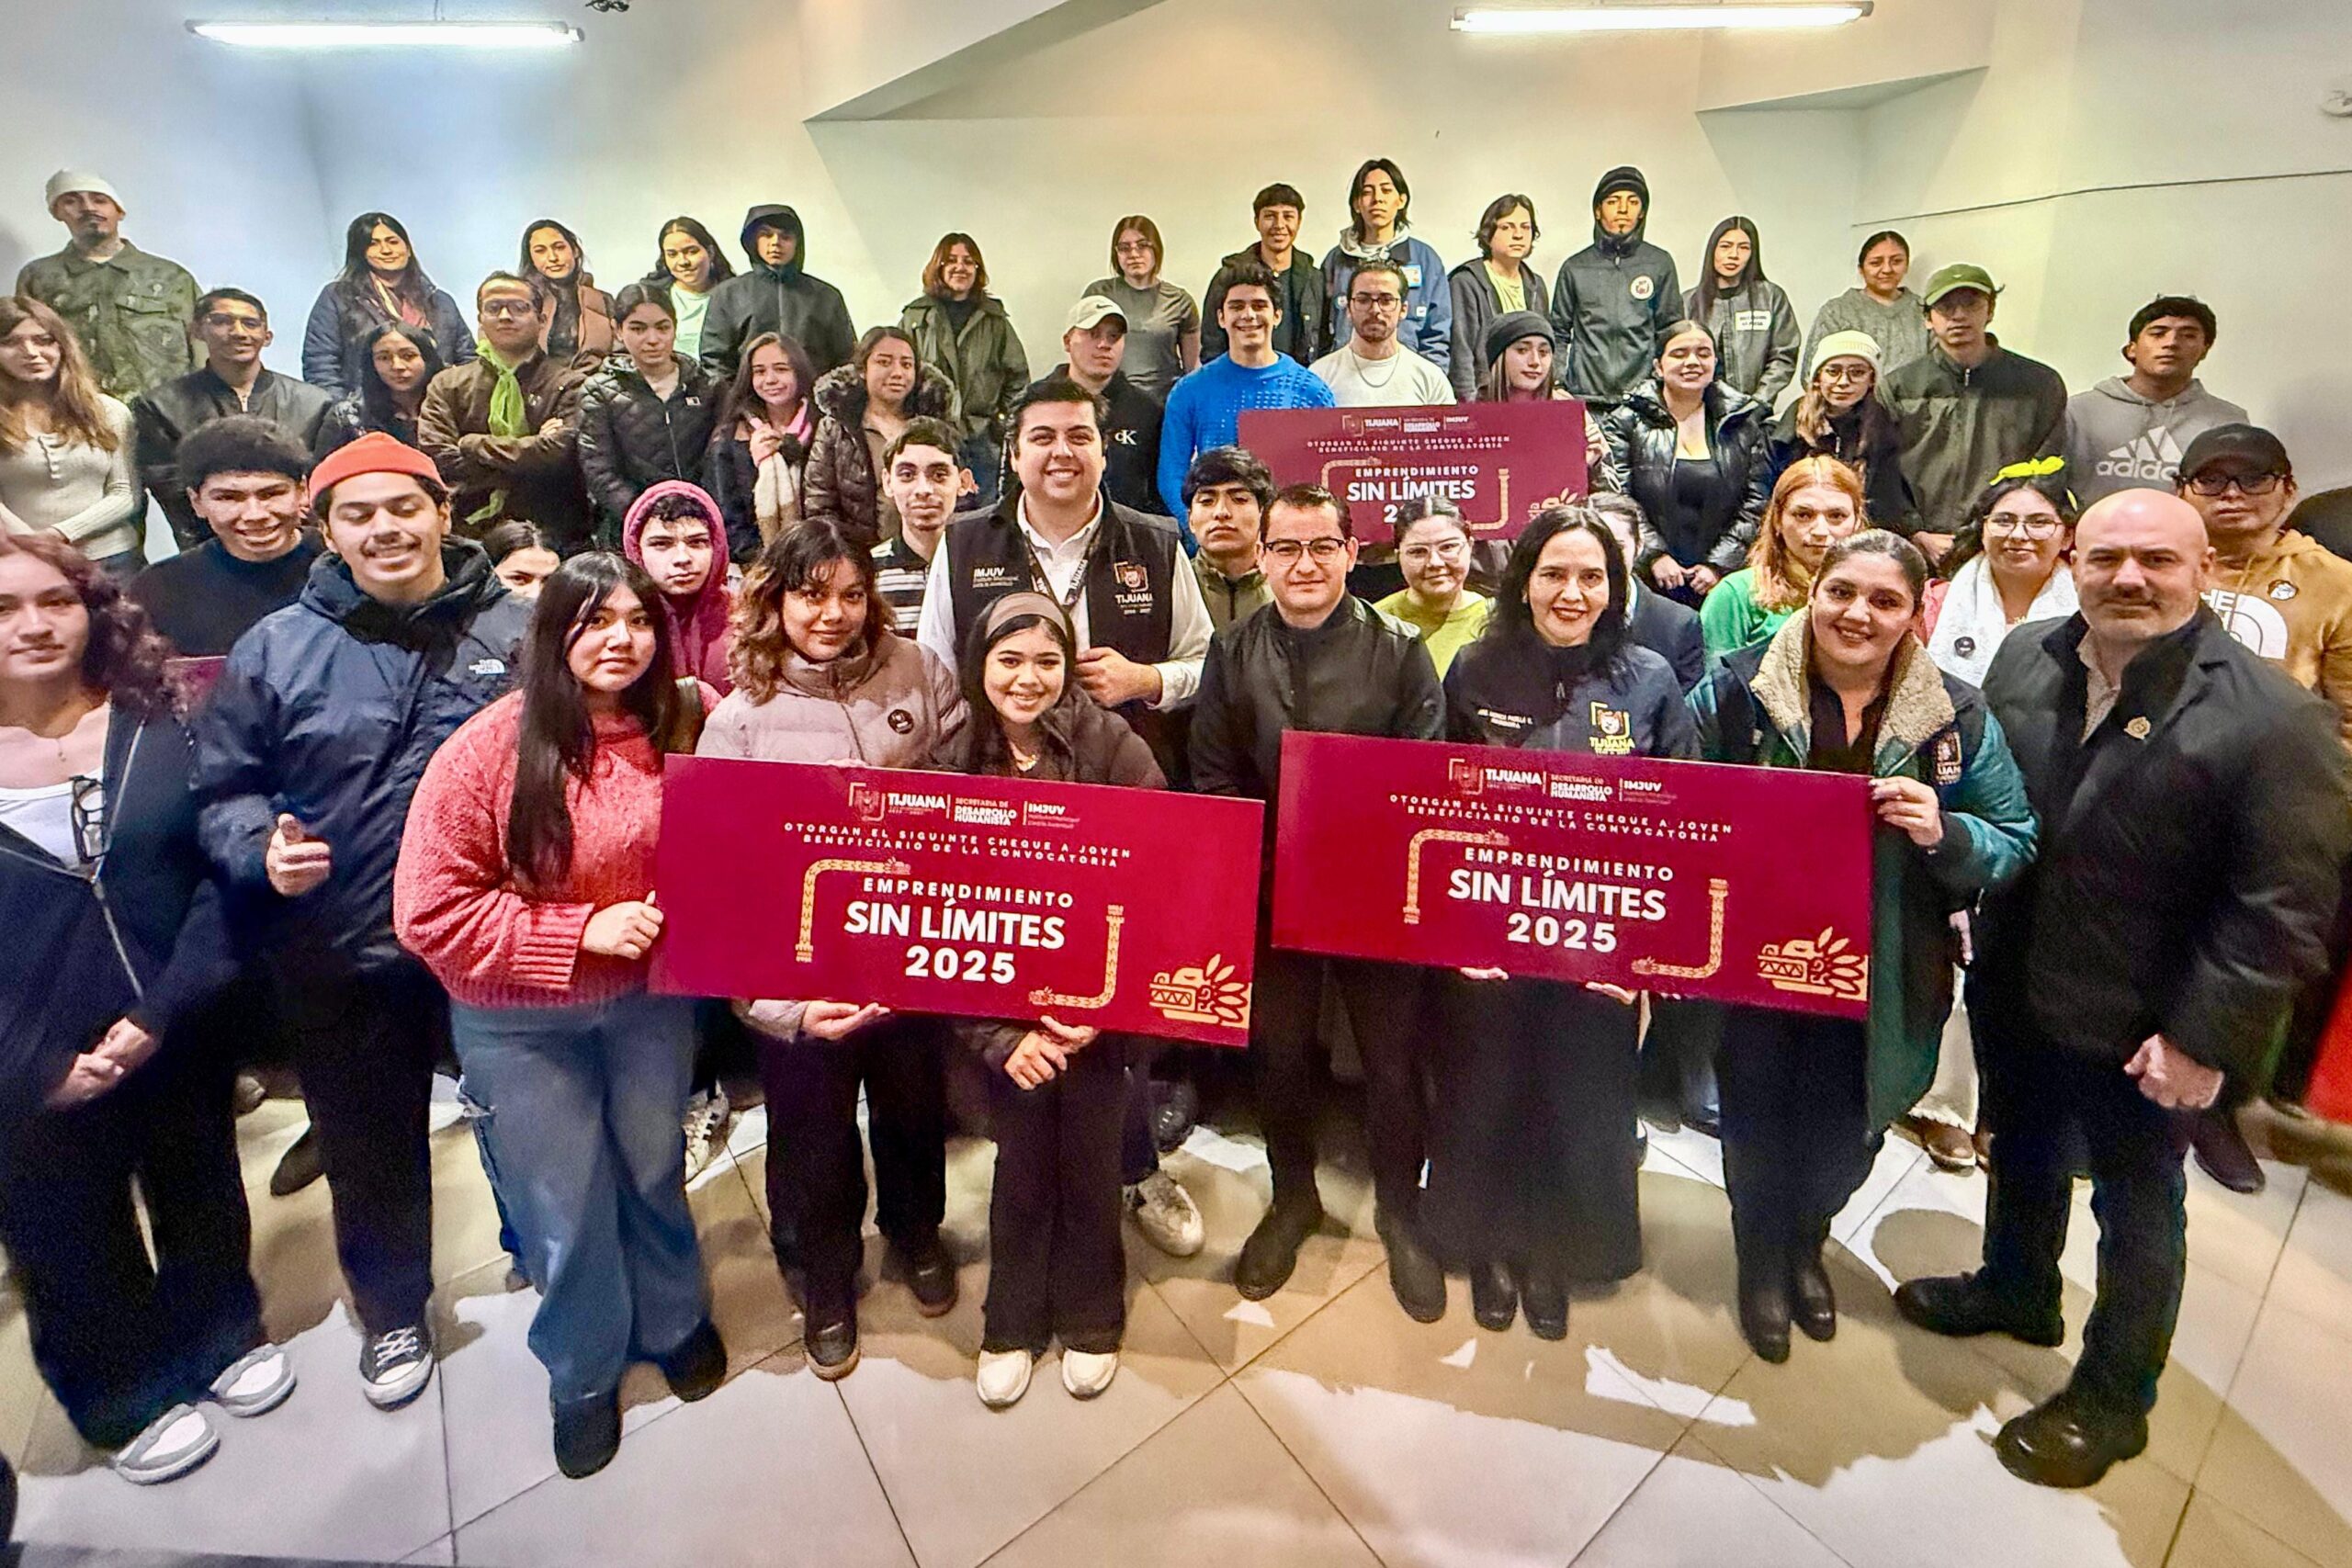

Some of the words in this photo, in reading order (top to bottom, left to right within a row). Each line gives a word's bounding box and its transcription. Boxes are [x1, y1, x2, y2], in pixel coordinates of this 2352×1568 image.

[1355, 465, 1479, 478] EMPRENDIMIENTO
[2096, 459, 2181, 481] adida
[1346, 480, 1385, 502] SIN
[1390, 475, 1476, 501] LÍMITES
[974, 567, 1005, 578] IMJUV
[1114, 593, 1153, 604] TIJUANA
[2199, 588, 2236, 612] HE
[1589, 736, 1635, 749] TIJUANA
[1485, 768, 1543, 785] TIJUANA
[1623, 780, 1662, 792] IMJUV
[1550, 789, 1608, 802] HUMANISTA
[1551, 782, 1612, 795] DESARROLLO
[888, 793, 946, 809] TIJUANA
[1028, 803, 1066, 815] IMJUV
[954, 812, 1012, 826] HUMANISTA
[955, 806, 1017, 819] DESARROLLO
[1389, 794, 1462, 808] OTORGAN
[1471, 801, 1488, 811] EL
[1498, 804, 1574, 820] SIGUINTE
[1584, 812, 1648, 826] CHEQUE
[1659, 818, 1668, 828] A
[1679, 820, 1732, 833] JOVEN
[1408, 805, 1521, 824] BENEFICIARIO
[1531, 817, 1549, 827] DE
[1558, 819, 1577, 829] LA
[1587, 822, 1718, 842] CONVOCATORIA
[784, 822, 861, 837] OTORGAN
[872, 828, 888, 839] EL
[899, 829, 978, 845] SIGUINTE
[988, 837, 1052, 851] CHEQUE
[1061, 843, 1069, 852] A
[1079, 844, 1131, 859] JOVEN
[803, 834, 923, 852] BENEFICIARIO
[933, 843, 952, 853] DE
[962, 845, 980, 856] LA
[989, 847, 1118, 868] CONVOCATORIA
[1464, 847, 1674, 882] EMPRENDIMIENTO
[863, 877, 1074, 908] EMPRENDIMIENTO
[1447, 868, 1511, 905] SIN
[1521, 868, 1667, 921] LÍMITES
[843, 900, 911, 937] SIN
[921, 897, 1066, 950] LÍMITES
[1507, 912, 1618, 953] 2025
[905, 944, 1016, 985] 2025
